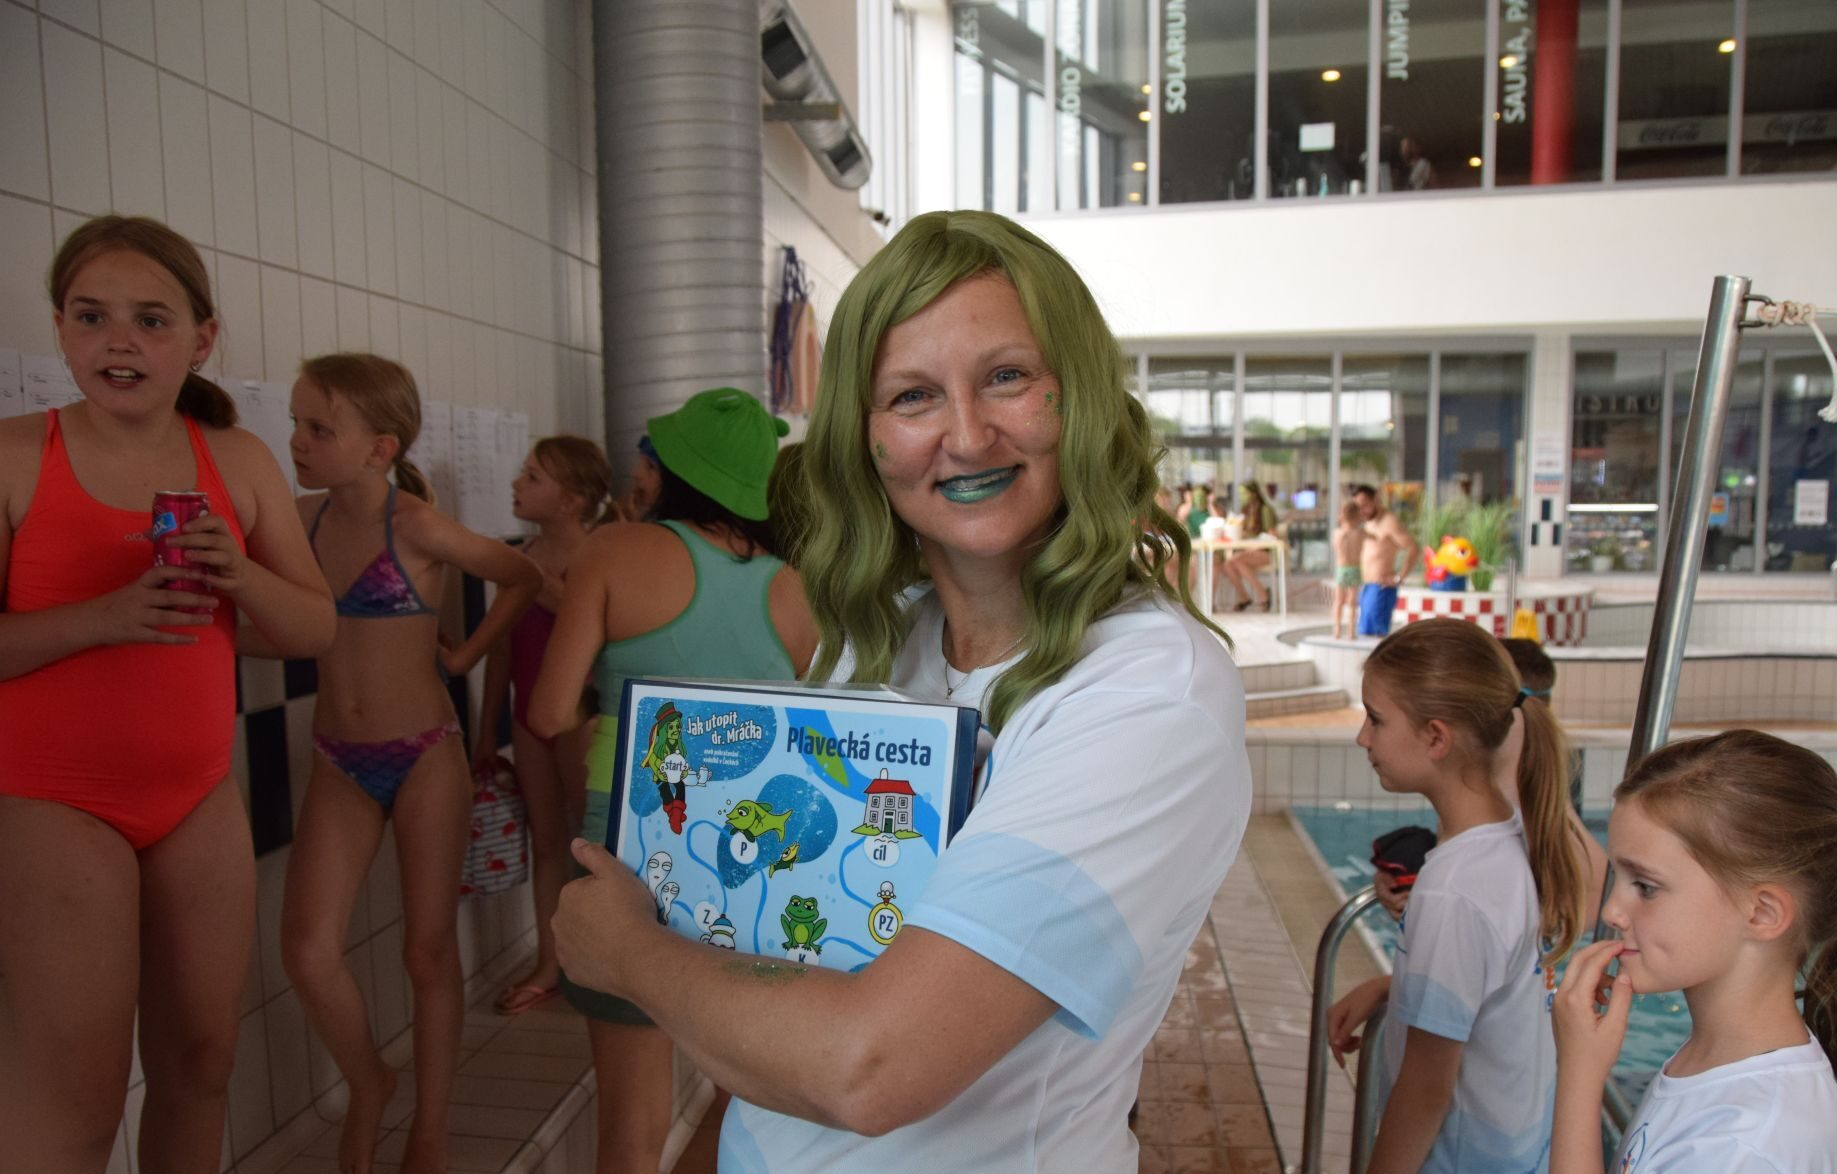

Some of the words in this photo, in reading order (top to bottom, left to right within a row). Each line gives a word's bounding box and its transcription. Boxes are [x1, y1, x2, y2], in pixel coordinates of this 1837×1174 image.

[687, 716, 704, 735] Jak
[705, 712, 737, 730] utopit
[711, 730, 725, 745] dr.
[727, 720, 762, 743] Mráčka
[786, 727, 870, 761] Plavecká
[875, 736, 931, 767] cesta
[664, 761, 684, 772] start
[740, 842, 748, 857] P
[873, 844, 886, 860] cíl
[703, 909, 711, 925] Z
[878, 914, 894, 932] PZ
